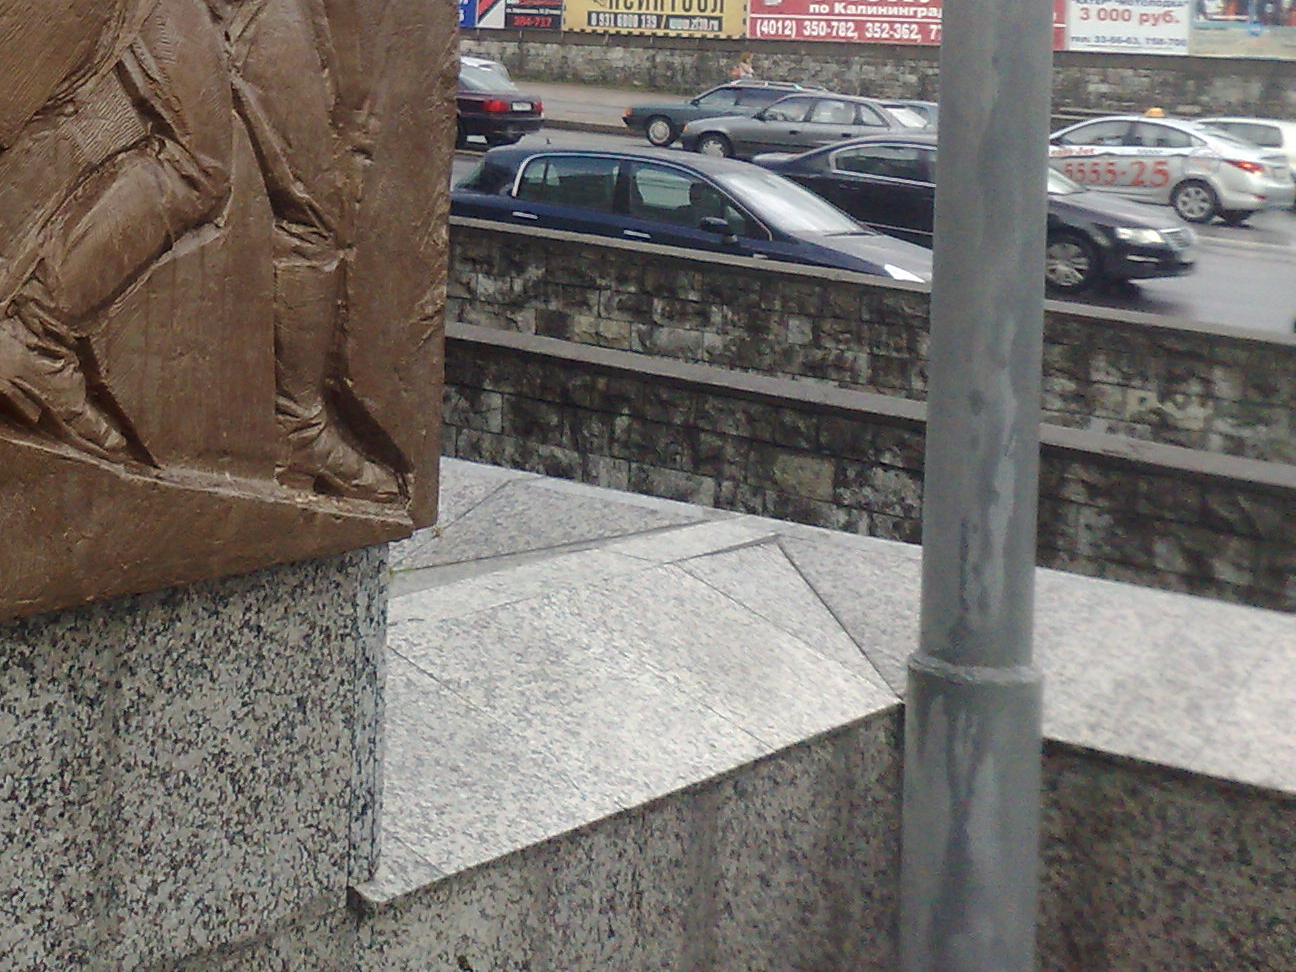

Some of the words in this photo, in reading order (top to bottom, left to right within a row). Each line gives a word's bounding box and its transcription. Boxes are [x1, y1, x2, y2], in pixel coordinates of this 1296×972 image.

[809, 4, 830, 15] по
[833, 2, 943, 18] Калинингра
[1080, 7, 1090, 21] 3
[1097, 8, 1132, 22] 000
[1139, 10, 1180, 27] руб.
[756, 20, 797, 38] (4012)
